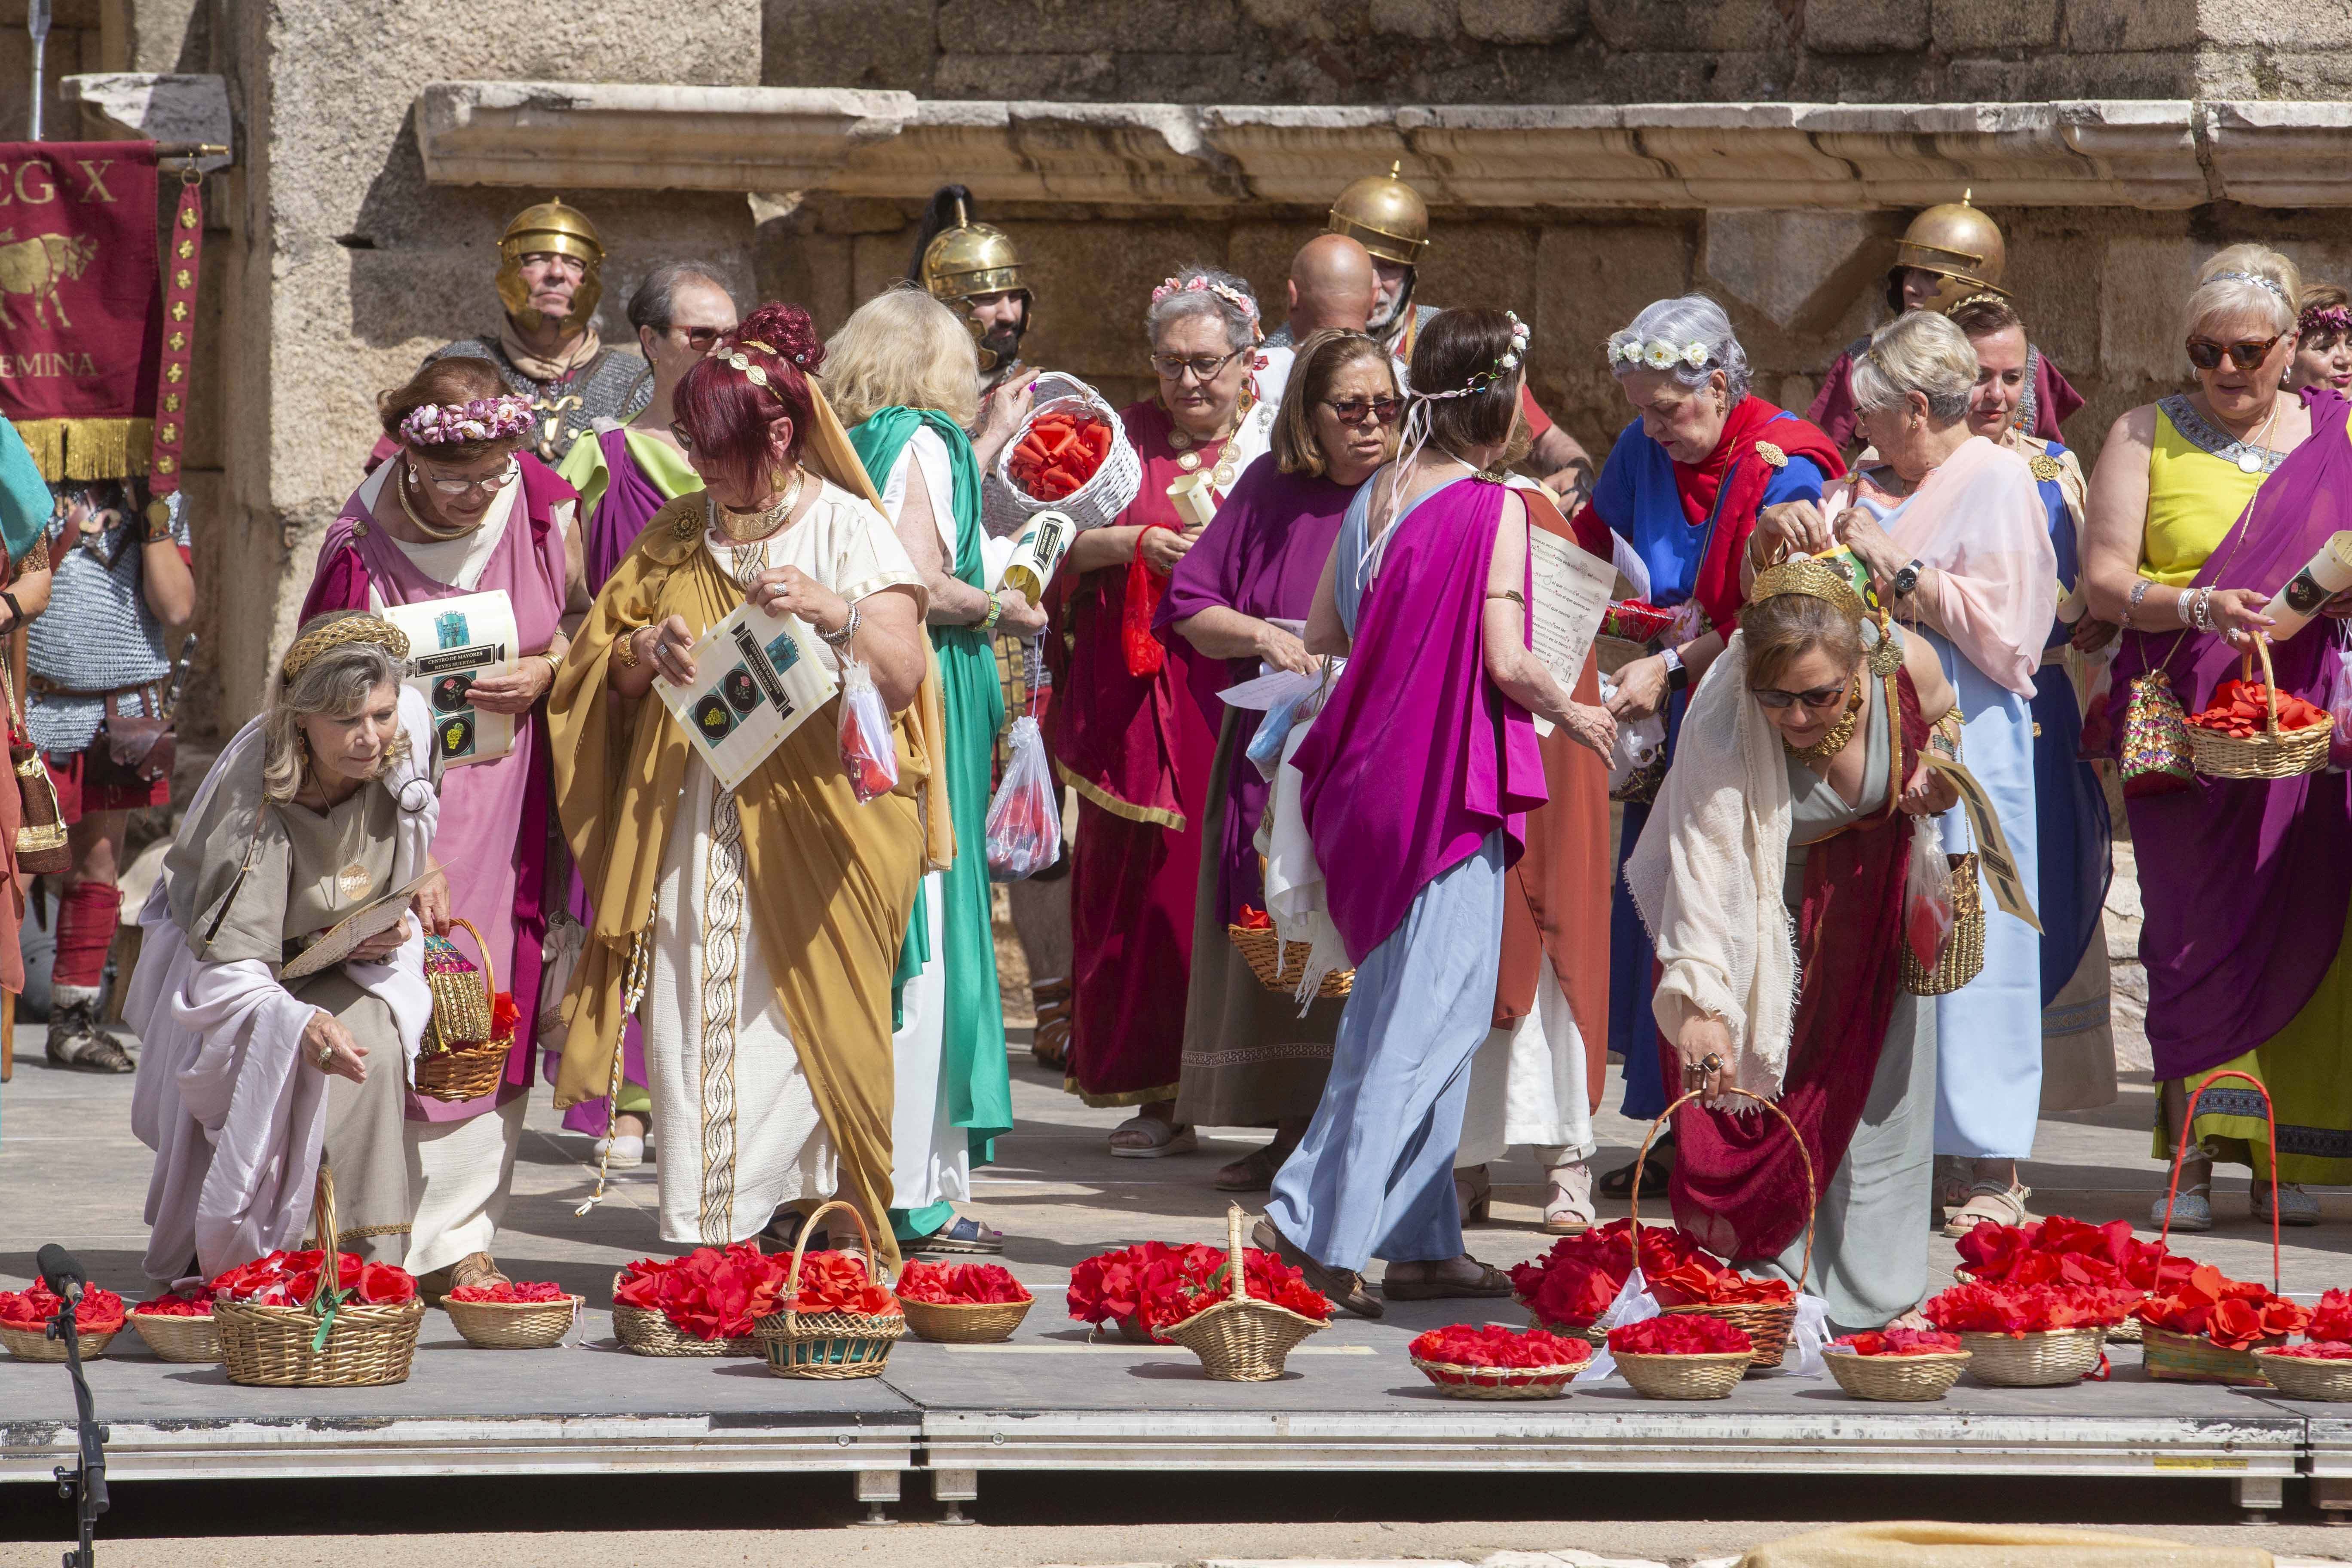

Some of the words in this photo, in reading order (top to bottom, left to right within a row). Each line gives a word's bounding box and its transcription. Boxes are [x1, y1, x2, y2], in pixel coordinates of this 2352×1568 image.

[1559, 609, 1571, 619] naciste
[1532, 646, 1547, 654] ambién
[458, 651, 483, 660] MAYORES
[452, 659, 475, 667] HUERTAS
[748, 654, 760, 671] REYES
[758, 669, 773, 692] HUERTAS
[750, 643, 763, 664] CENTRO
[760, 663, 767, 671] DE
[765, 670, 781, 695] MAYORES
